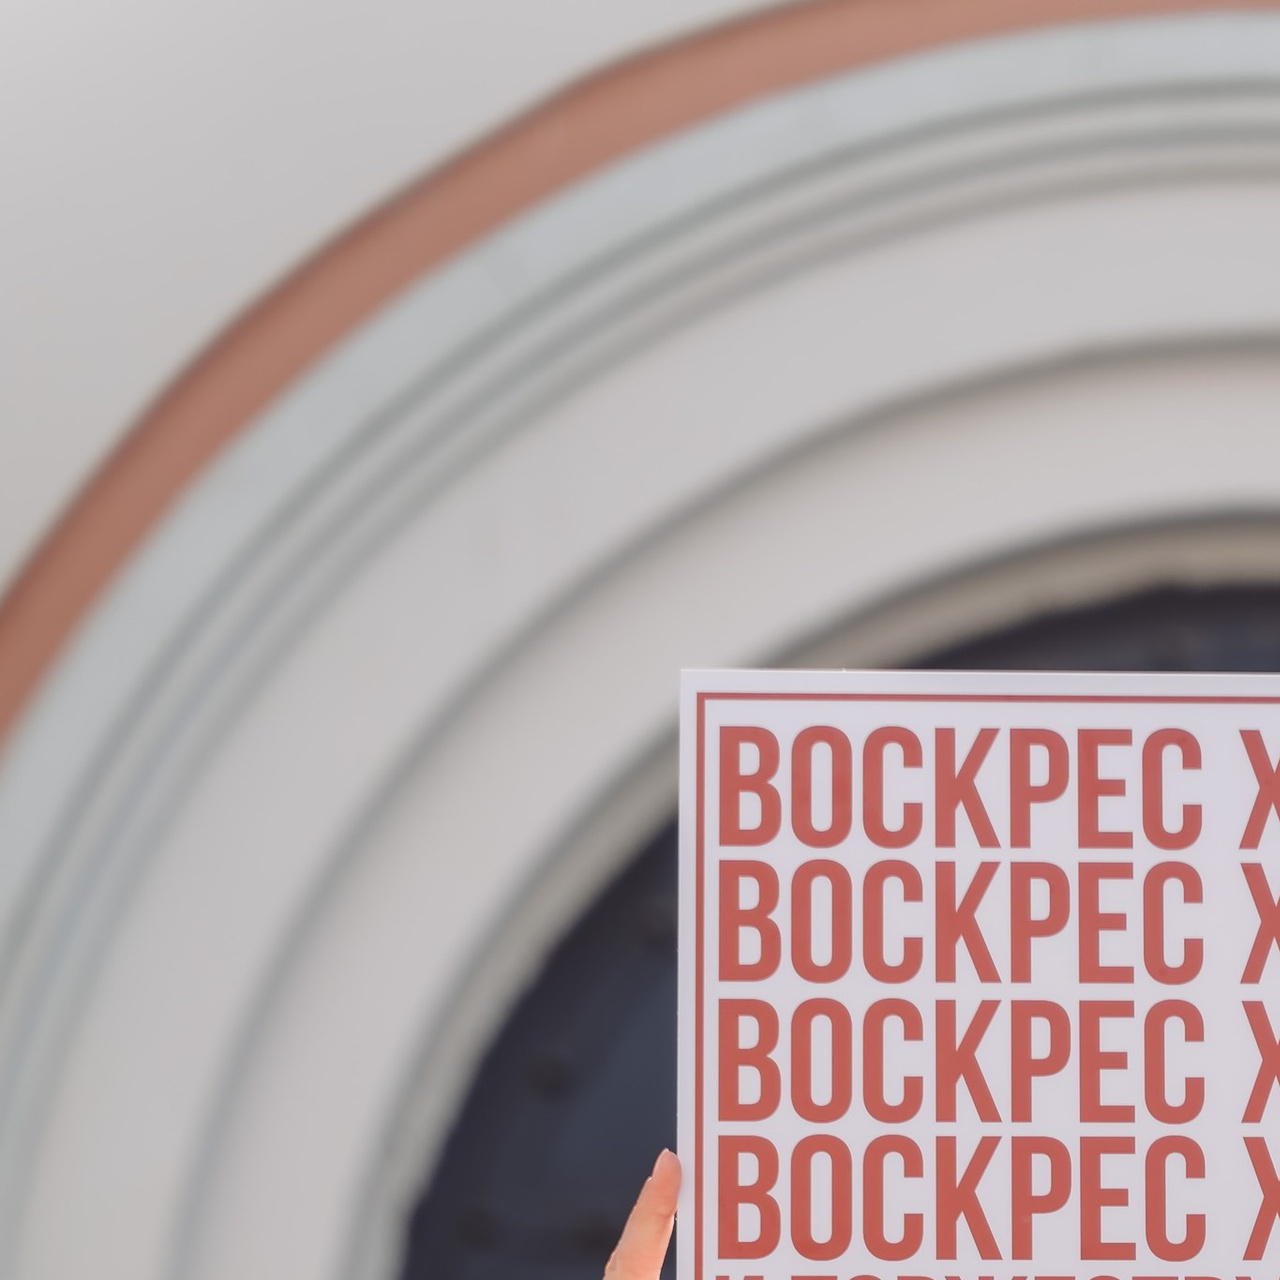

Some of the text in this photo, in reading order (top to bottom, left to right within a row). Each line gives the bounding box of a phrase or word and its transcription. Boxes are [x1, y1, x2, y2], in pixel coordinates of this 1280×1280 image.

[718, 725, 1202, 849] ВОСКРЕС
[717, 859, 1204, 985] ВОСКРЕС
[717, 997, 1205, 1124] ВОСКРЕС
[716, 1133, 1206, 1262] ВОСКРЕС
